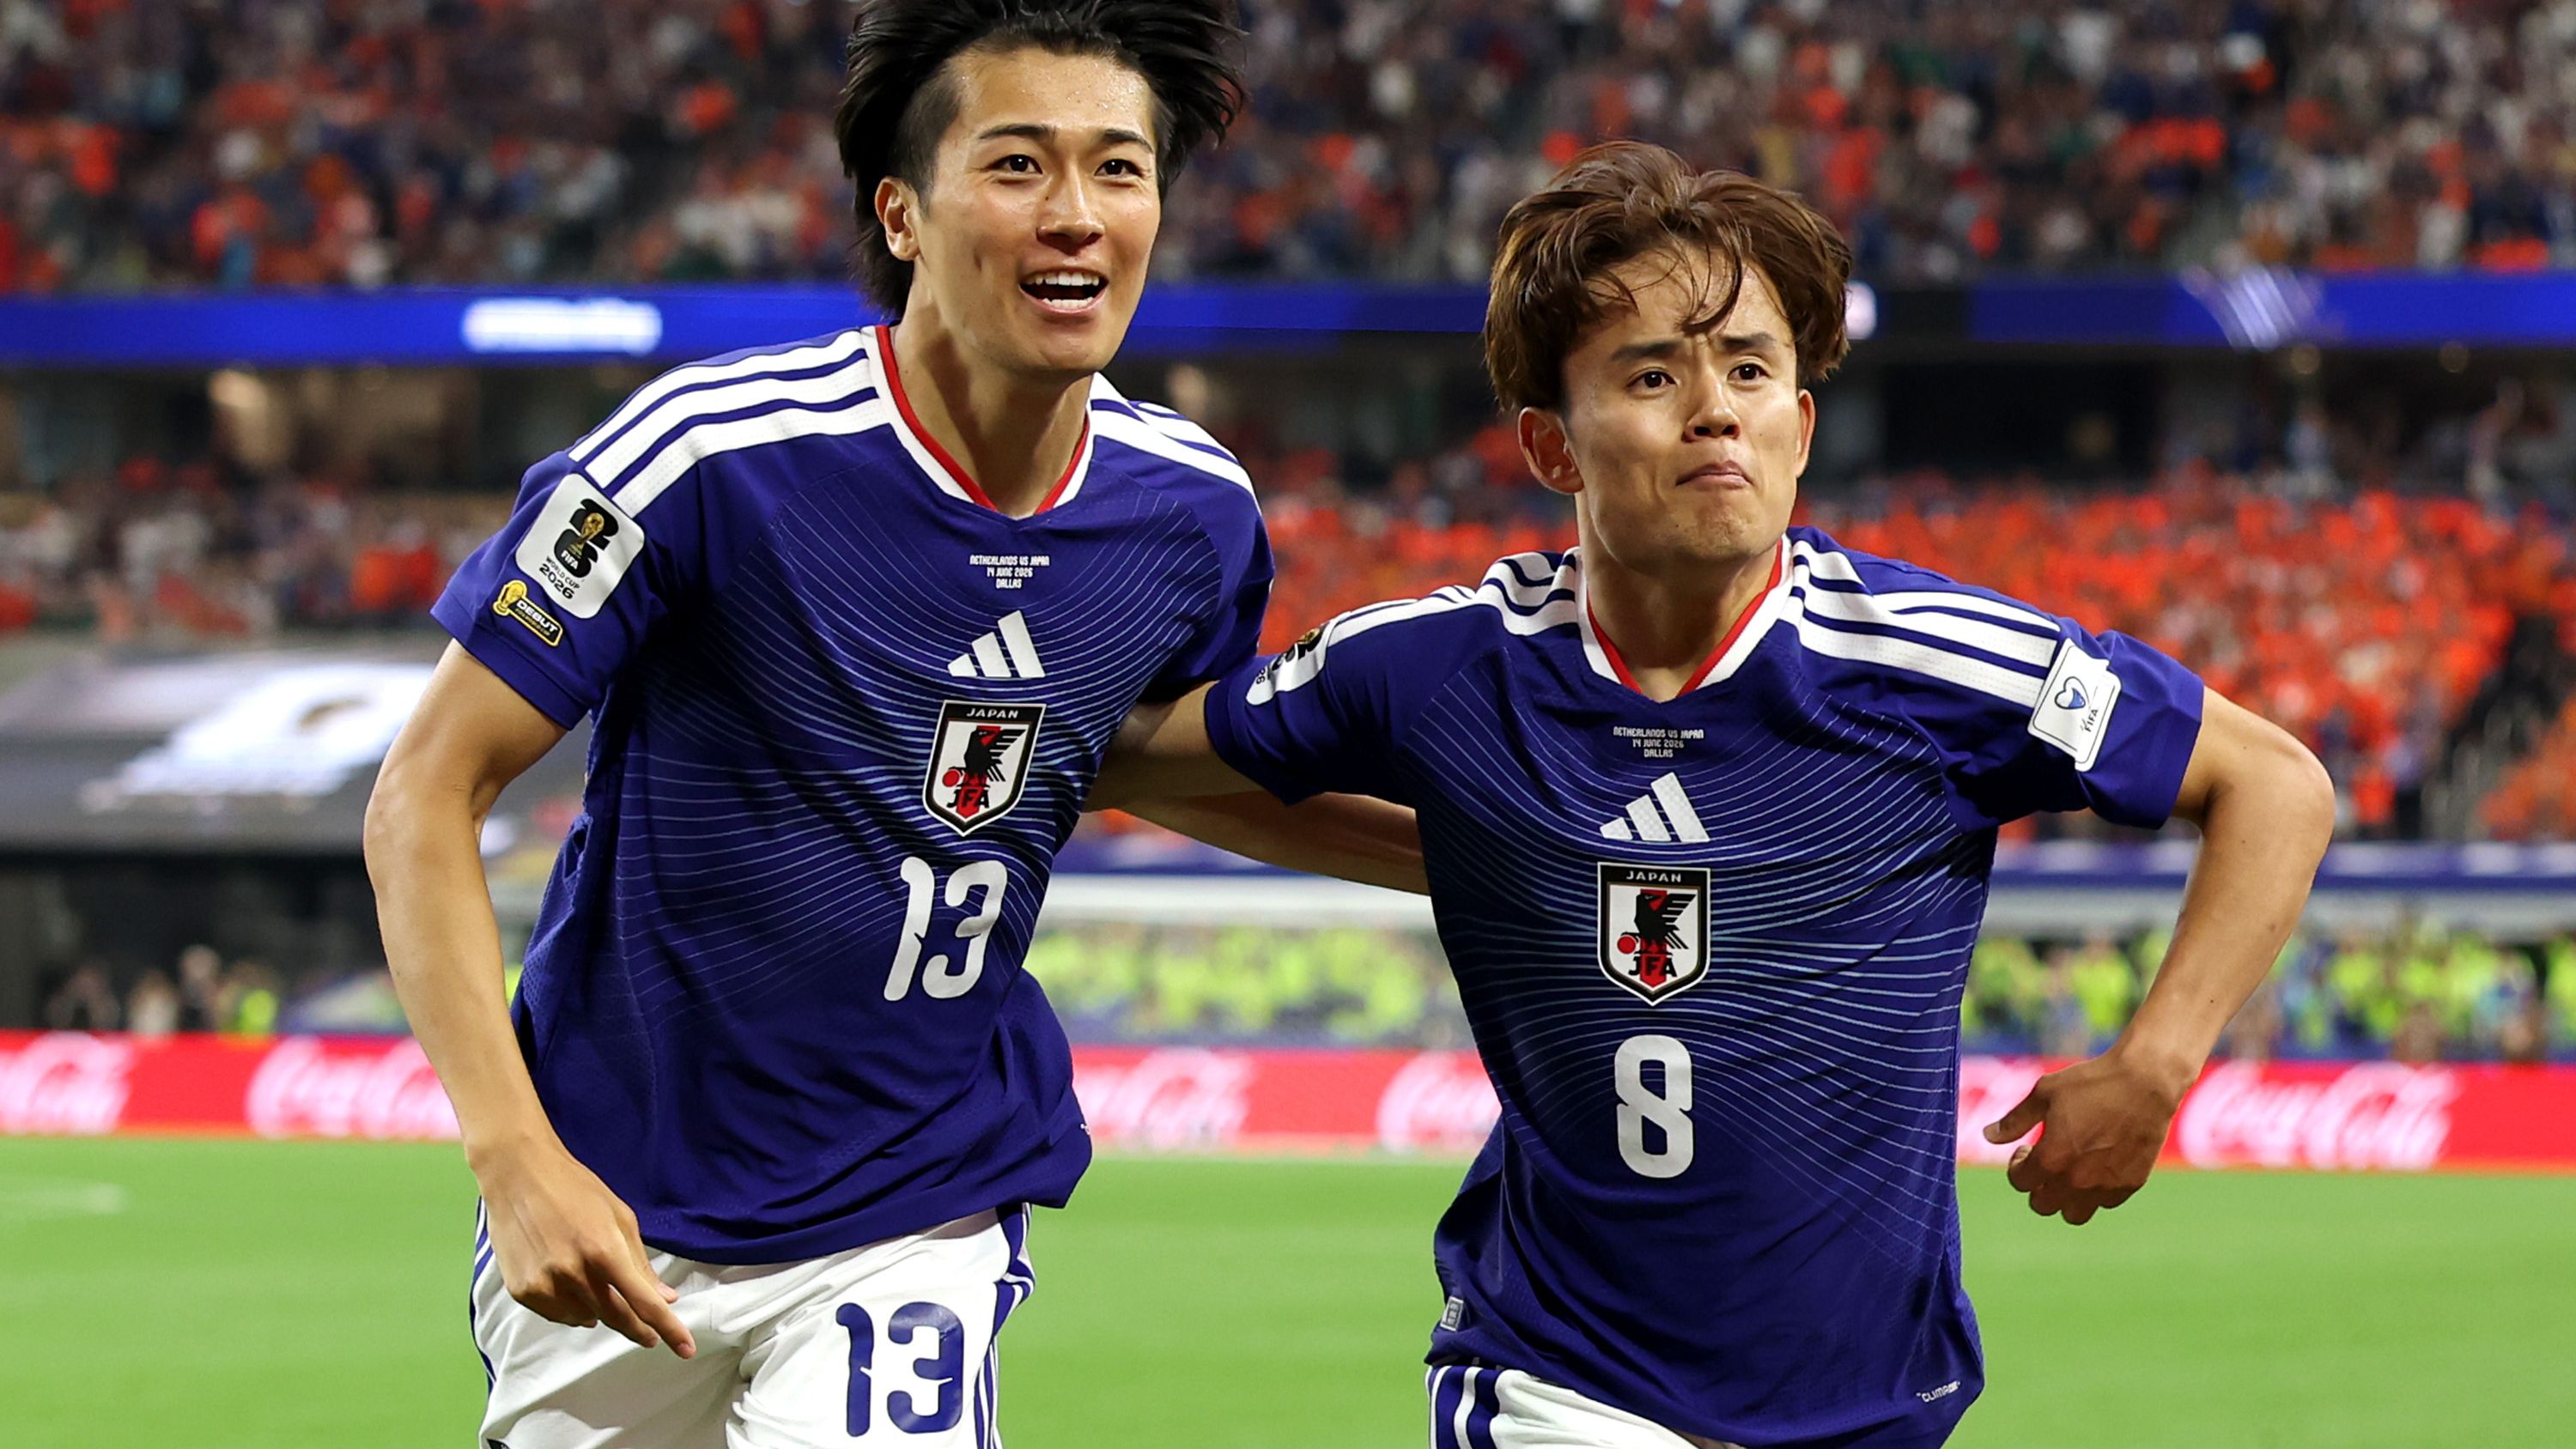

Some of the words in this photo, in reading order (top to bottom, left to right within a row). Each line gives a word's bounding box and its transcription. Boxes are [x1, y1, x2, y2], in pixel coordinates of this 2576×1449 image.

[561, 549, 579, 570] FIFA
[969, 555, 1018, 566] NETHERLANDS
[1030, 555, 1050, 567] JAPAN
[538, 563, 575, 600] 2026
[546, 555, 566, 579] WORLD
[564, 576, 580, 590] CUP
[987, 567, 995, 578] 14
[996, 567, 1013, 578] JUNE
[1014, 567, 1033, 579] 2026
[996, 578, 1022, 589] DALLAS
[516, 600, 558, 633] DEBUT
[966, 707, 1019, 719] JAPAN
[1613, 726, 1666, 738] NETHERLANDS
[1680, 729, 1704, 739] JAPAN
[1632, 738, 1642, 748] 14
[1643, 738, 1662, 749] JUNE
[1663, 739, 1685, 749] 2026
[1643, 748, 1674, 758] DALLAS
[946, 789, 990, 809] JFA
[1625, 870, 1682, 883] JAPAN
[884, 856, 1008, 1002] 13
[1628, 955, 1678, 978] JFA
[1614, 1034, 1694, 1179] 8
[835, 1301, 964, 1438] 13
